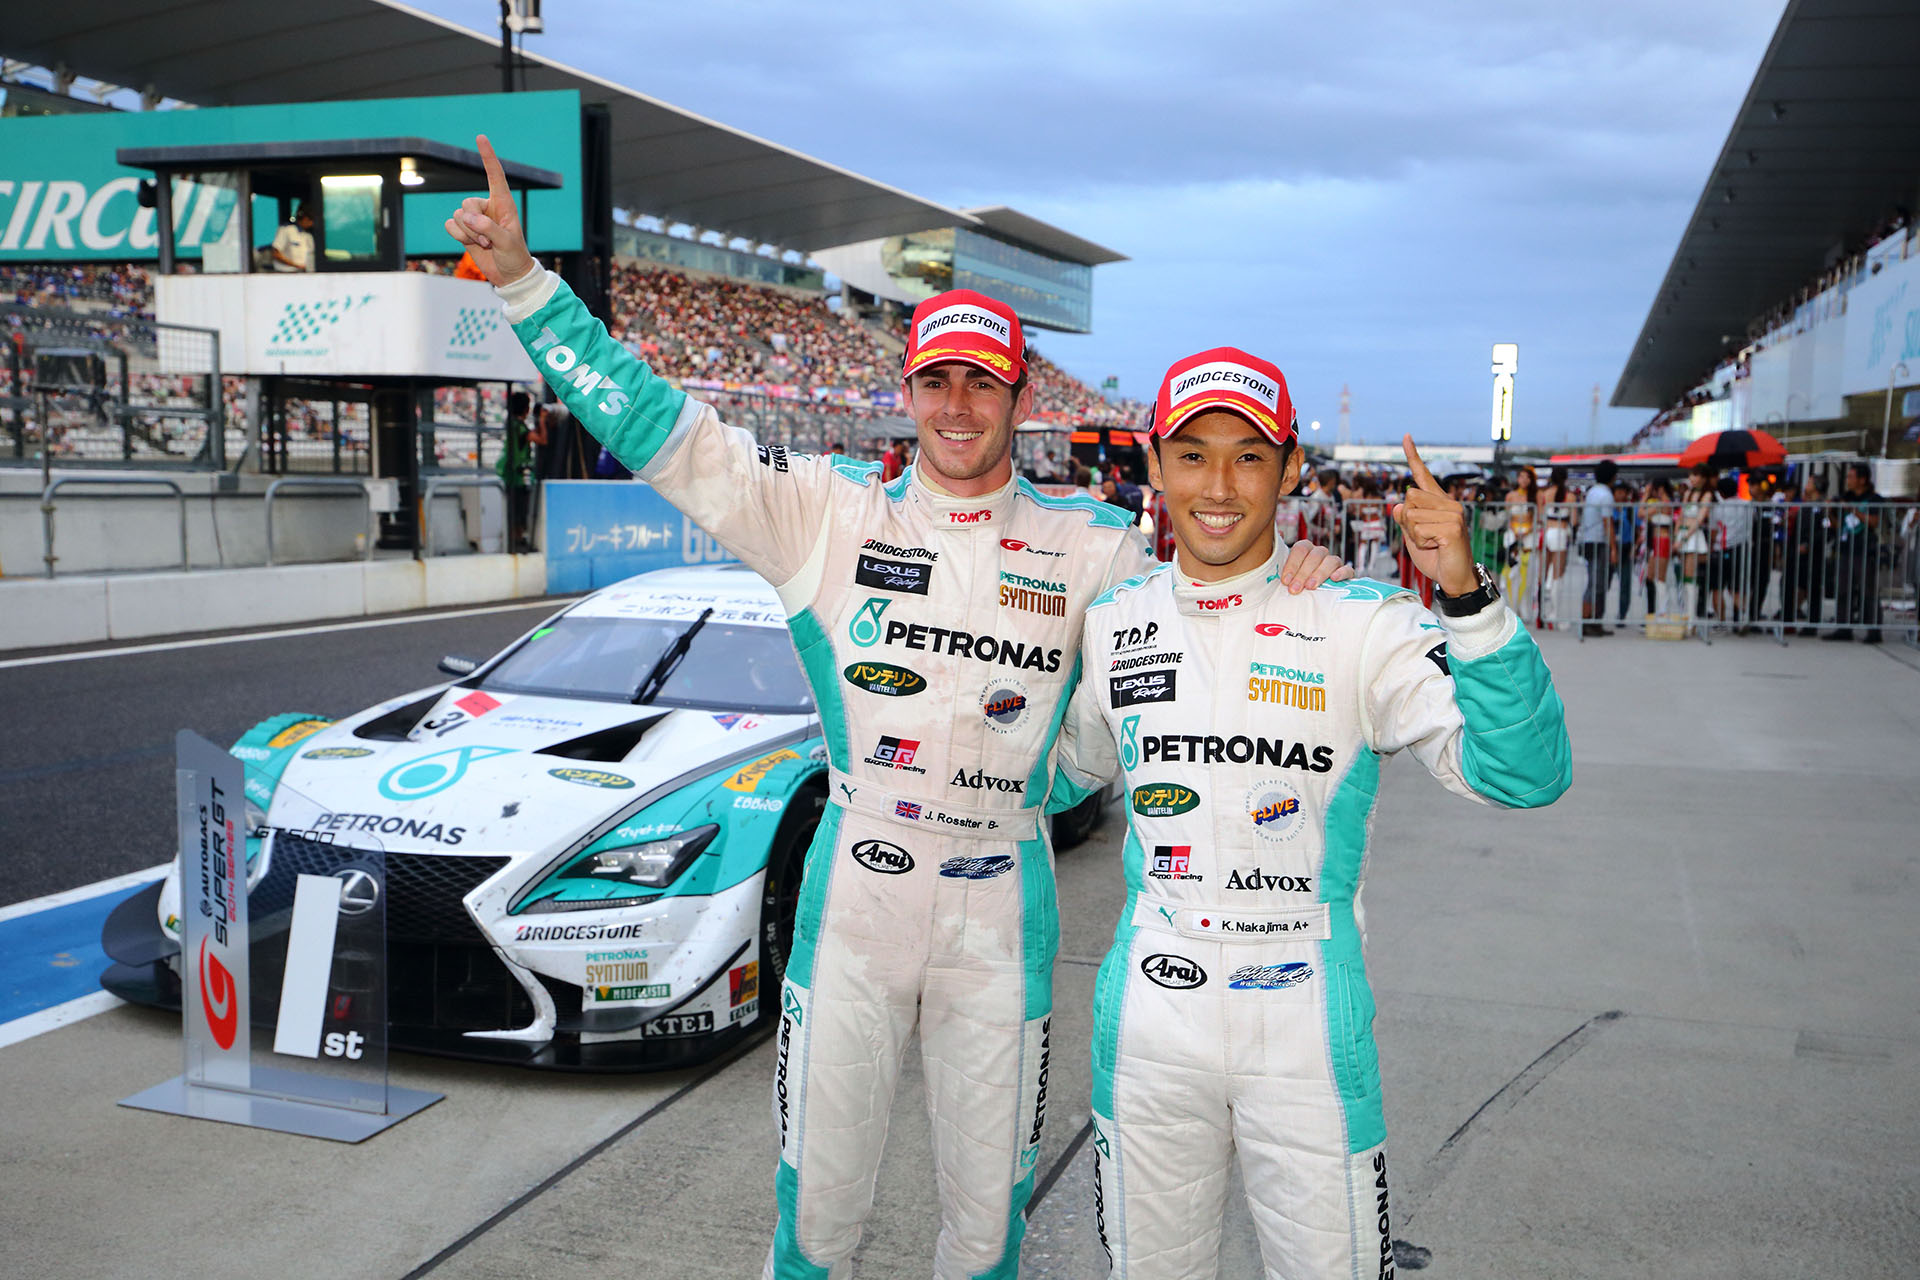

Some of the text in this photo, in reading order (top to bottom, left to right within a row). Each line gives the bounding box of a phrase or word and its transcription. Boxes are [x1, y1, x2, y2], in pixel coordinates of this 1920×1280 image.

[0, 177, 238, 250] IRCUI
[920, 313, 1007, 338] BRIDGESTONE
[530, 326, 630, 417] TOM'S
[1174, 371, 1275, 400] BRIDGESTONE
[949, 509, 993, 523] TOM'S
[861, 538, 939, 561] BRIDGESTONE
[863, 560, 921, 577] LEXUS
[1000, 570, 1067, 593] PETRONAS
[999, 585, 1066, 617] SYNTIUM
[1196, 594, 1243, 610] TOM'S
[617, 604, 785, 622] ニッポン元気に
[885, 620, 1062, 673] PETRONAS
[1109, 652, 1183, 672] BRIDGESTONE
[1250, 661, 1325, 684] PETRONAS
[853, 665, 919, 687] バンテリン
[1113, 675, 1166, 691] LEXUS
[1248, 677, 1326, 712] SYNTIUM
[875, 744, 914, 763] GR
[1143, 735, 1334, 773] PETRONAS
[950, 768, 1024, 794] Advox
[1135, 789, 1192, 806] バンテリン
[924, 811, 933, 821] J.
[937, 813, 982, 829] Rossiter
[1250, 797, 1298, 824] T-LIVE
[311, 813, 467, 845] PETRONAS
[200, 804, 209, 898] AUTOBACS
[211, 776, 228, 947] SUPER GT
[855, 843, 907, 869] Arai
[1154, 856, 1188, 871] GR
[1225, 868, 1312, 892] Advox
[515, 924, 642, 941] BRIDGESTONE
[1293, 920, 1309, 931] A+
[585, 950, 648, 962] PETRONAS
[585, 962, 648, 983] SYNTIUM
[1145, 957, 1199, 983] Arai
[1029, 1016, 1051, 1145] PETRONAS
